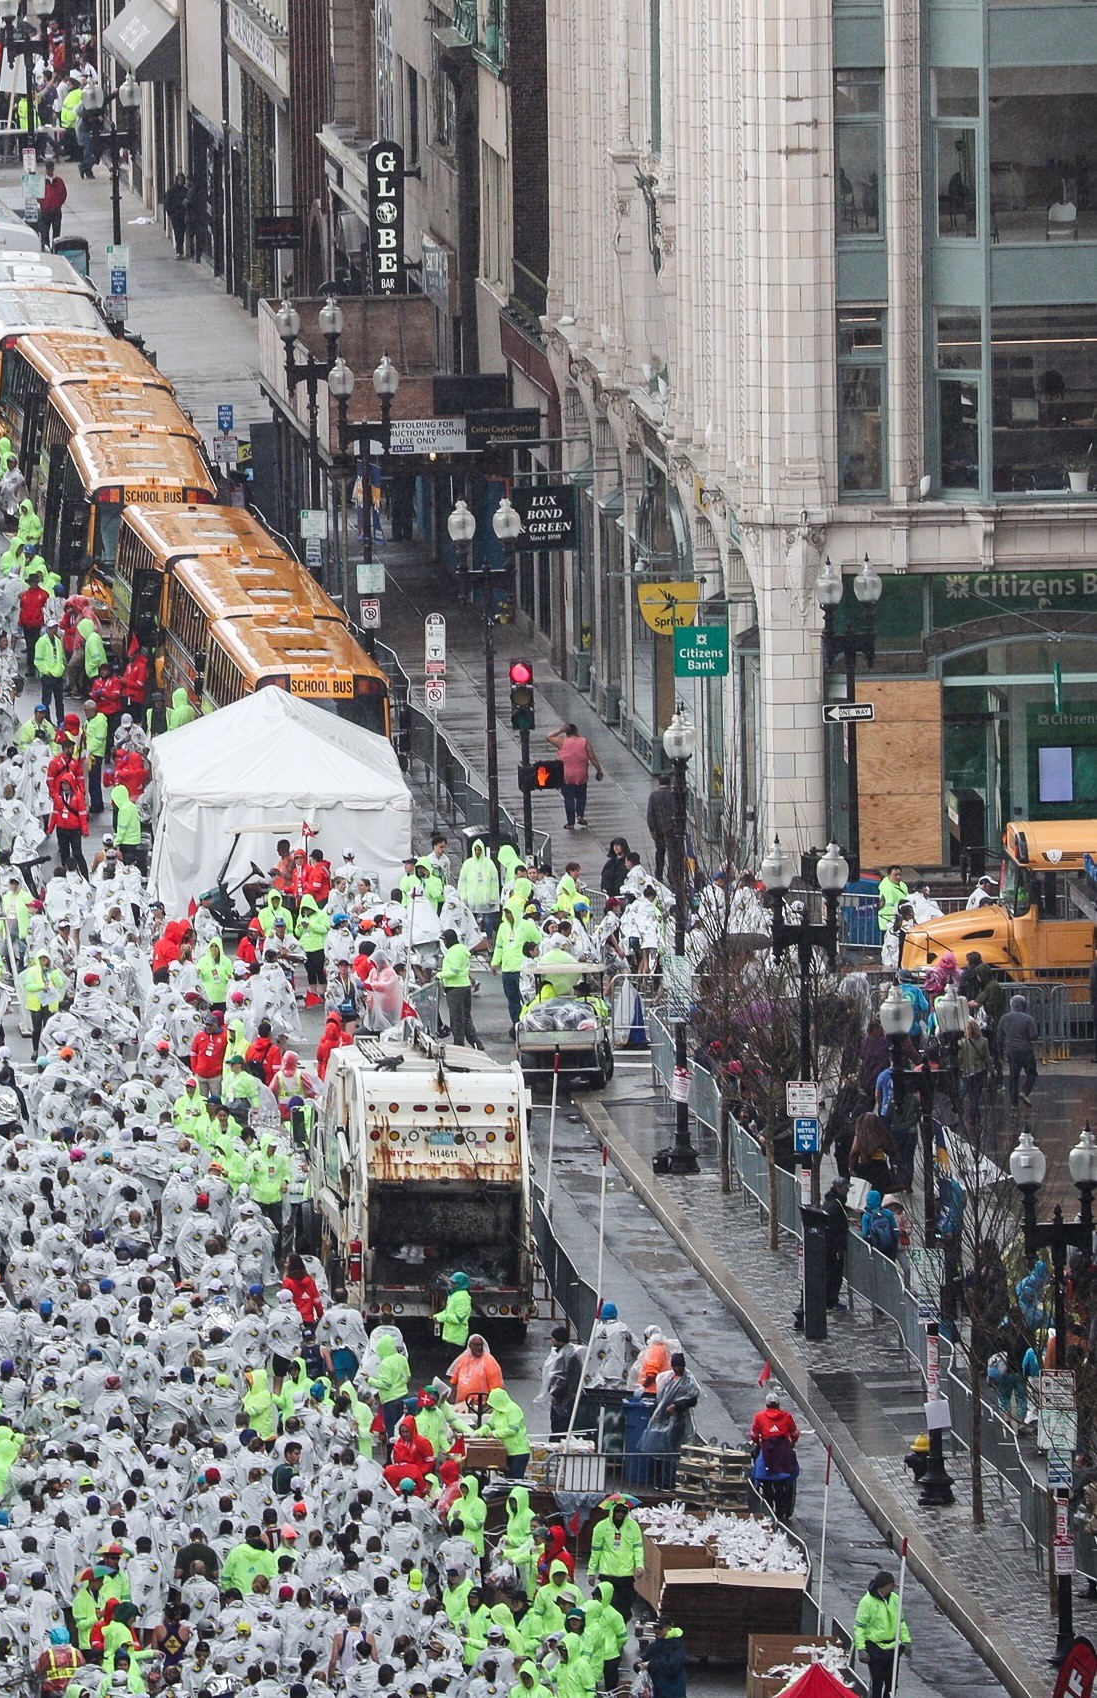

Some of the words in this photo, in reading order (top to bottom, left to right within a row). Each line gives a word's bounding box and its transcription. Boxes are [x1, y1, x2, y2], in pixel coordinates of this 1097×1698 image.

[381, 278, 395, 289] BAR
[392, 421, 436, 429] AFFOLDING
[391, 430, 425, 438] RUCTION
[125, 490, 162, 503] SCHOOL
[163, 491, 182, 504] BUS
[532, 495, 557, 506] LUX
[527, 508, 563, 520] BOND
[529, 521, 572, 533] GREEN
[547, 533, 562, 541] 1898
[974, 573, 1076, 598] Citizens
[679, 648, 724, 659] Citizens
[687, 660, 715, 670] Bank
[291, 680, 330, 693] SCHOOL
[333, 680, 353, 693] BUS
[838, 709, 852, 717] ONE
[855, 707, 869, 715] WAY
[429, 1149, 458, 1158] H14611
